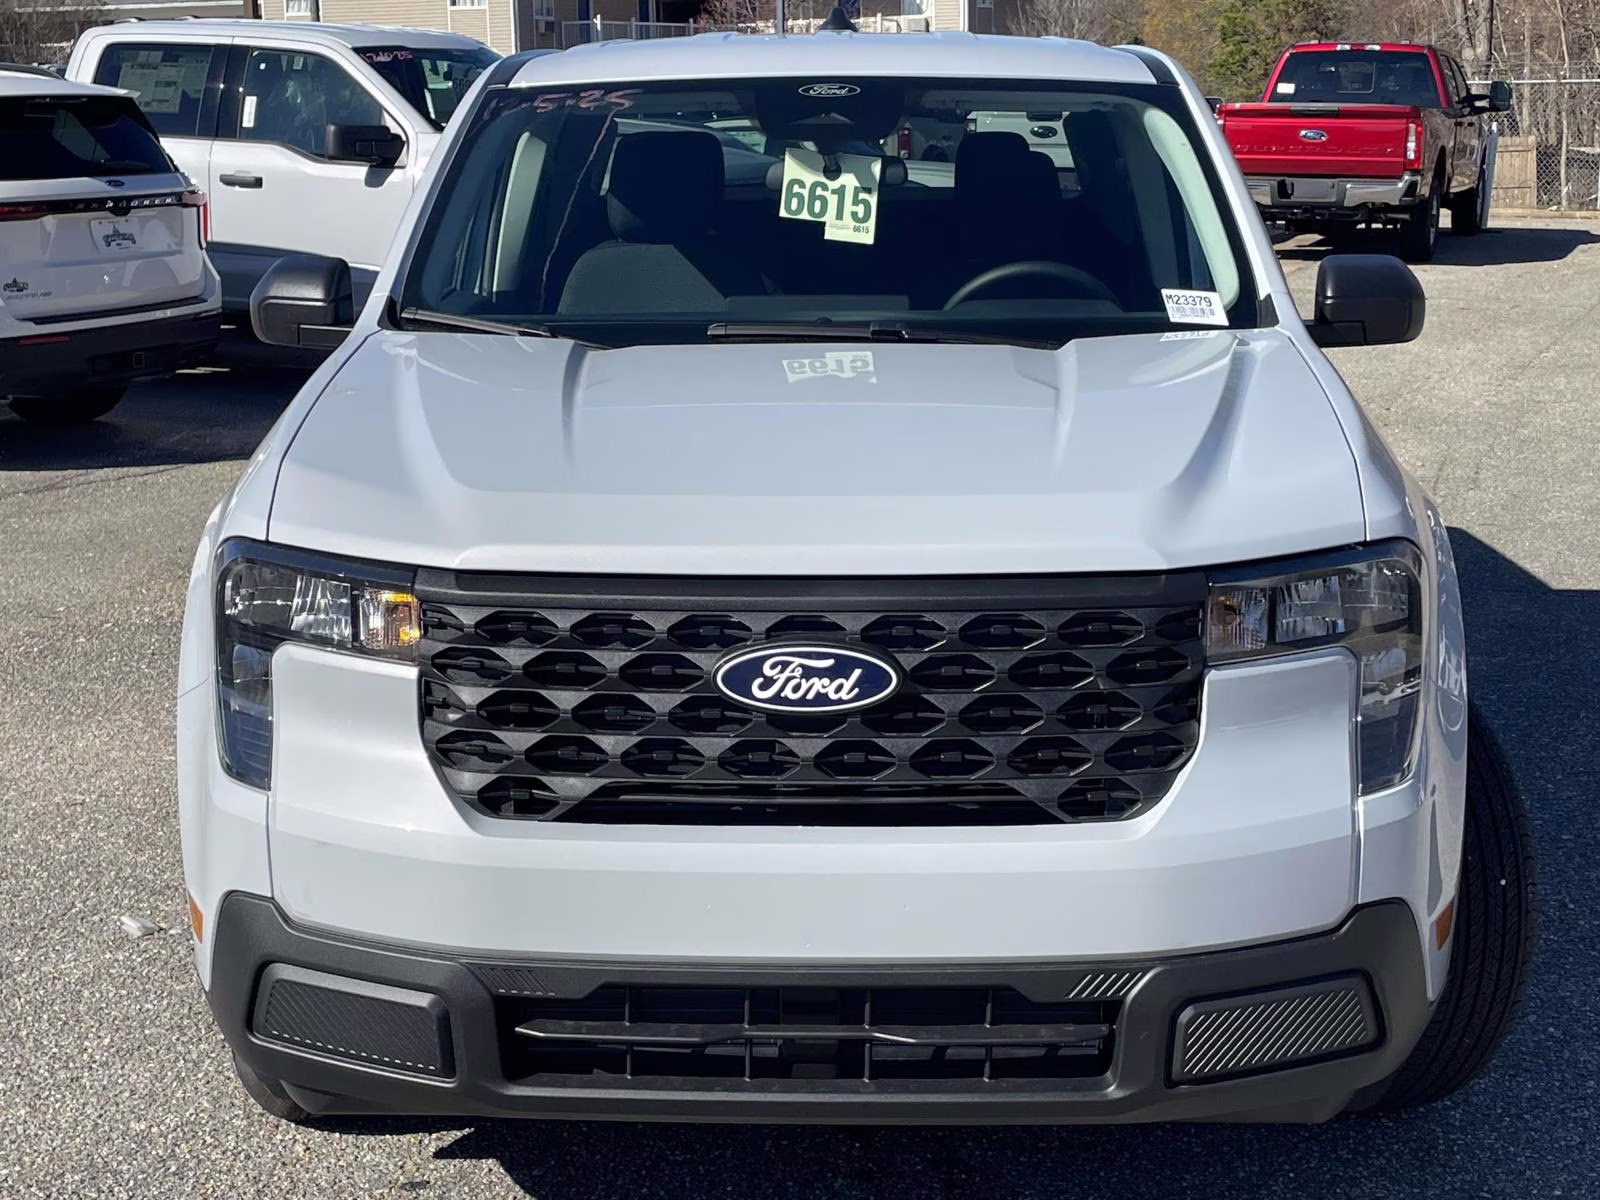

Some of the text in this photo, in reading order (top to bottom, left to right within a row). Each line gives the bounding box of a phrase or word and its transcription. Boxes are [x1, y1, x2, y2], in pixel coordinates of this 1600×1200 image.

[808, 85, 849, 95] Ford
[783, 178, 873, 224] 6615
[852, 224, 870, 234] 6615
[1165, 294, 1213, 307] M23379
[751, 655, 863, 701] Ford
